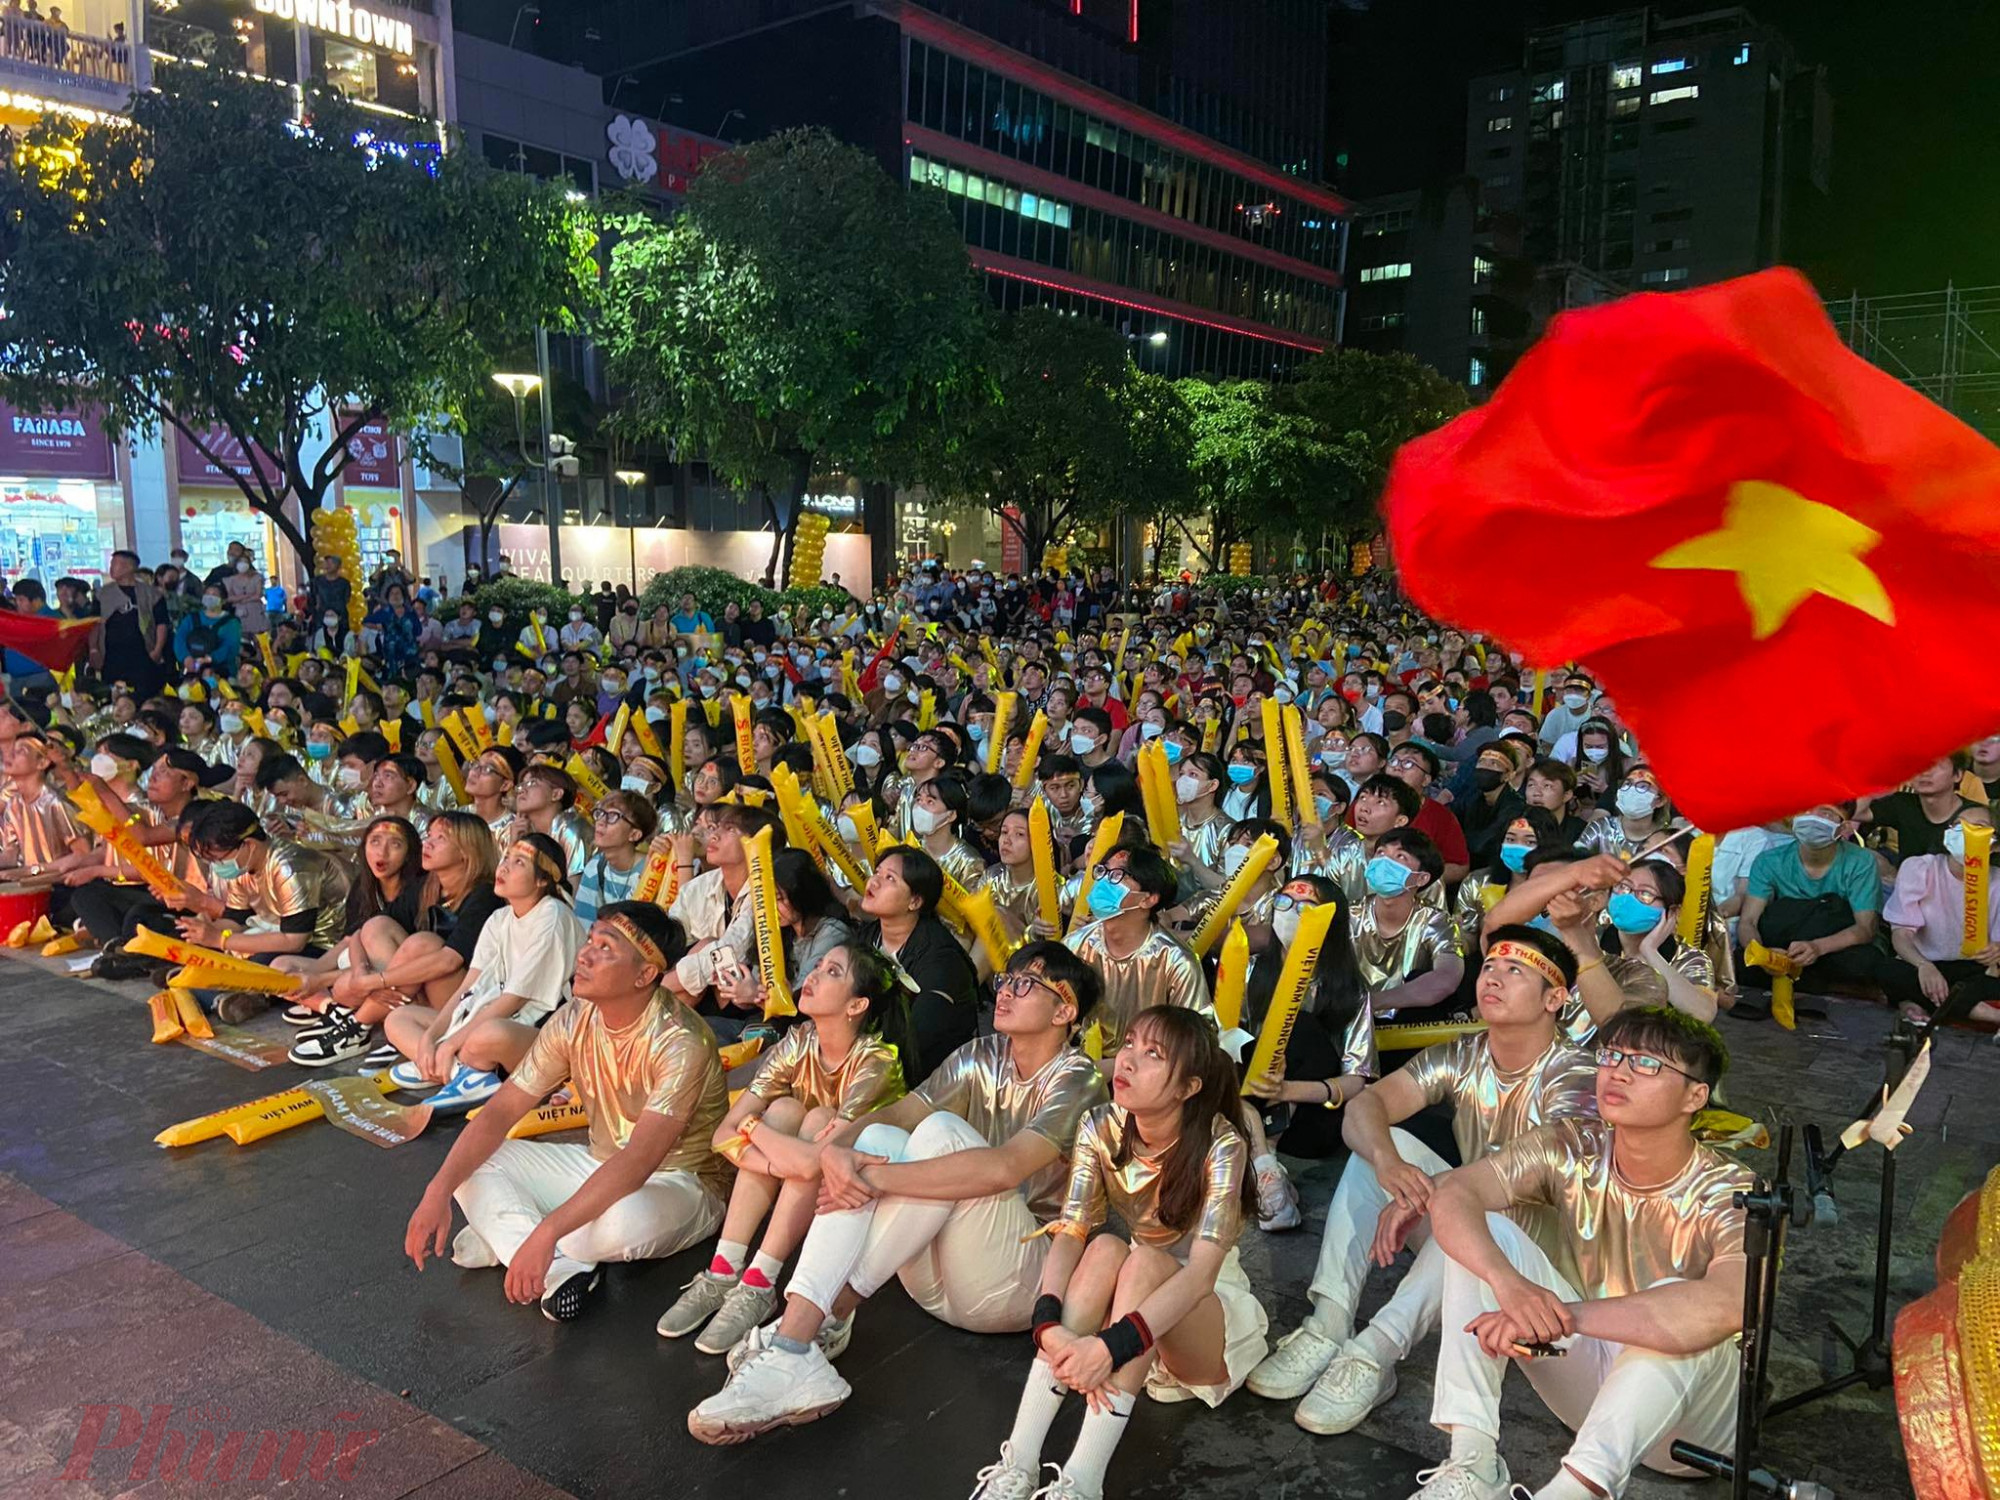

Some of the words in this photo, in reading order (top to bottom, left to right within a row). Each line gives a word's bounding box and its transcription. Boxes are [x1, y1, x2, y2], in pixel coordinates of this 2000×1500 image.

[508, 566, 656, 584] EAQUARTERS
[1965, 873, 1979, 895] BIA
[754, 884, 765, 911] NAM
[1191, 918, 1209, 942] NAM
[1291, 976, 1308, 1004] NAM
[288, 1098, 315, 1113] NAM
[537, 1107, 567, 1121] VIỆT
[569, 1104, 586, 1115] NA
